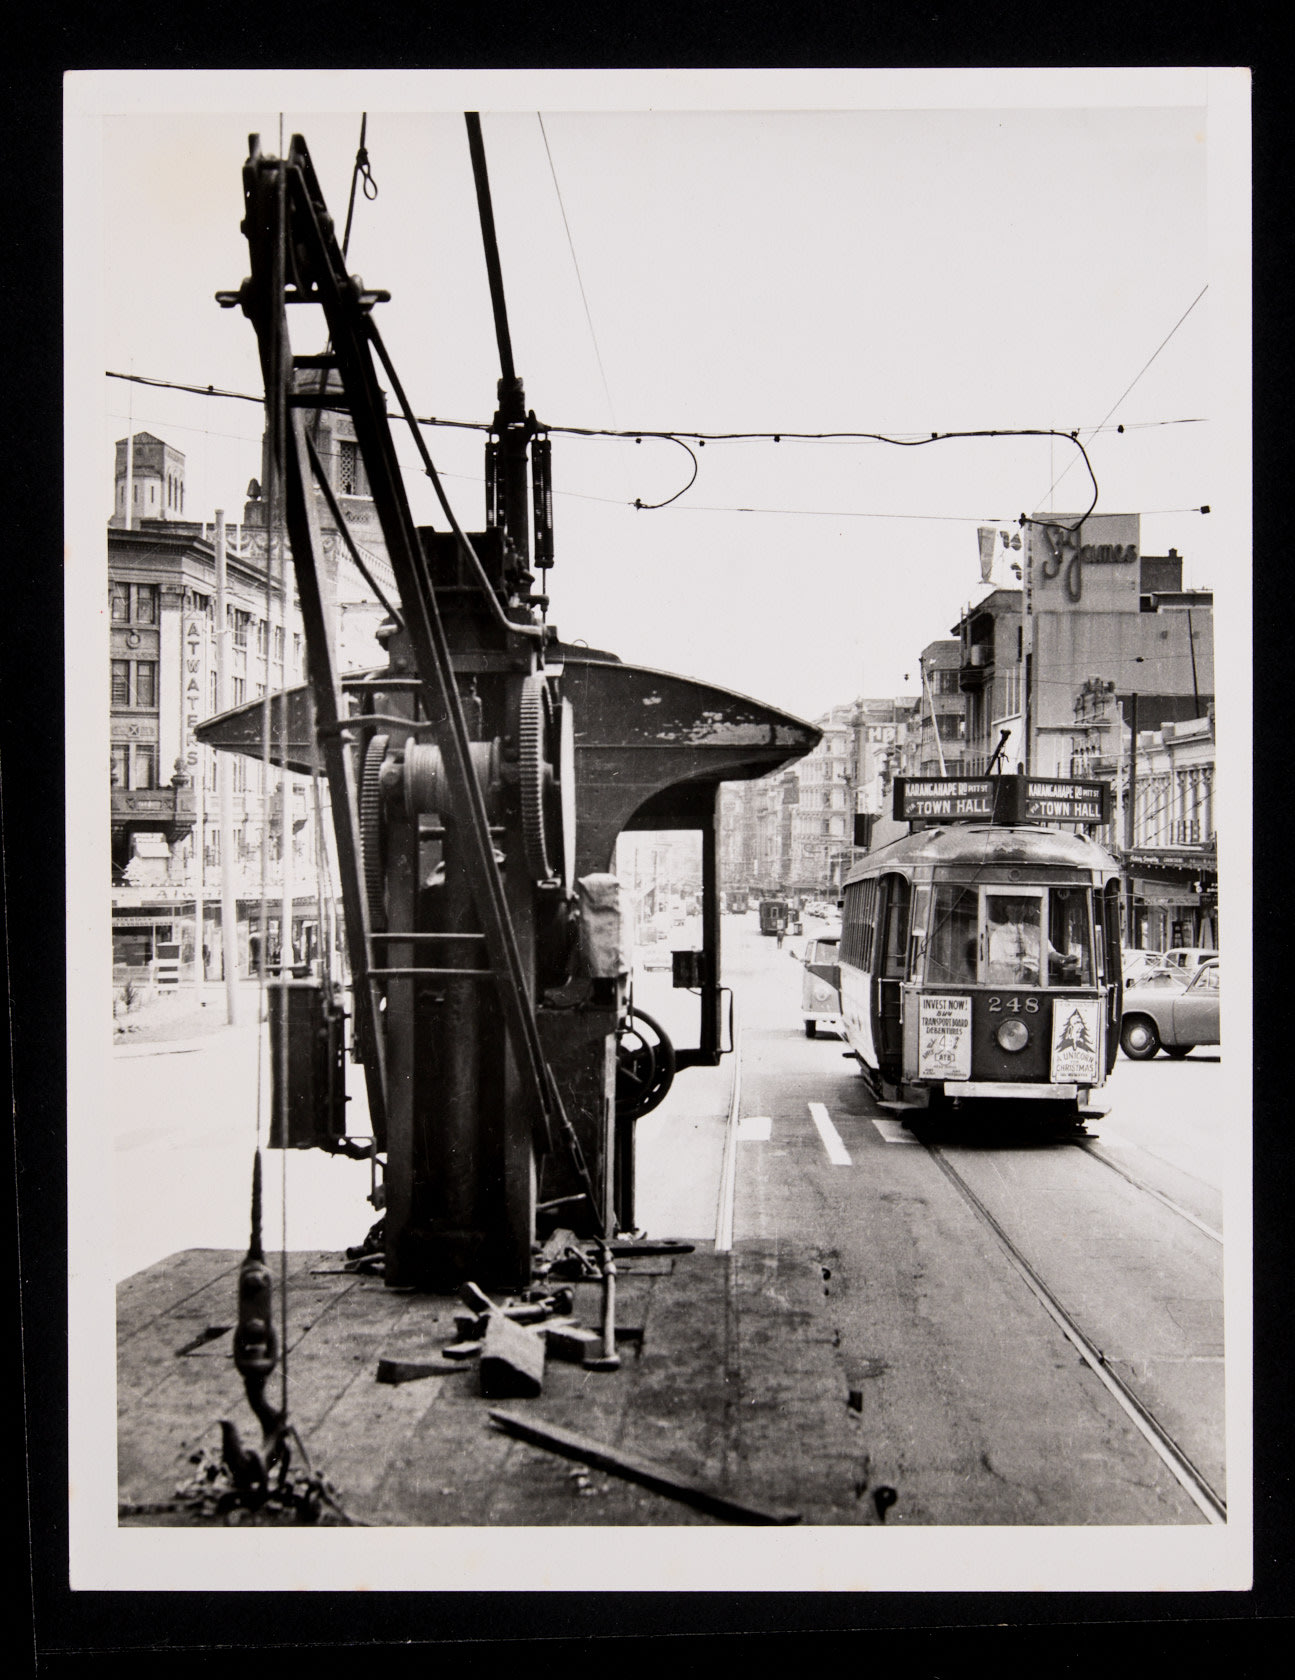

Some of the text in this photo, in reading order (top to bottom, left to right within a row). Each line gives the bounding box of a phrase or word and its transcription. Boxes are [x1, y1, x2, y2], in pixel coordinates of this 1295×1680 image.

[186, 622, 201, 767] ATWATERS
[905, 783, 957, 797] KARANGAHAPE
[968, 785, 980, 793] PITT
[1028, 784, 1074, 799] KARANGAHAPE
[1083, 789, 1093, 797] PITT
[916, 800, 951, 815] TOWN
[956, 799, 991, 814] HALL
[1039, 802, 1070, 816] TOWN
[1074, 802, 1101, 818] HALL
[923, 999, 968, 1011] INVEST NOW!
[988, 996, 1040, 1013] 248
[921, 1017, 969, 1028] TRANSPORT BOARD
[926, 1027, 963, 1036] DEBENTURES
[1063, 1051, 1094, 1063] UNICORN
[1056, 1064, 1094, 1072] CHRISTMAS
